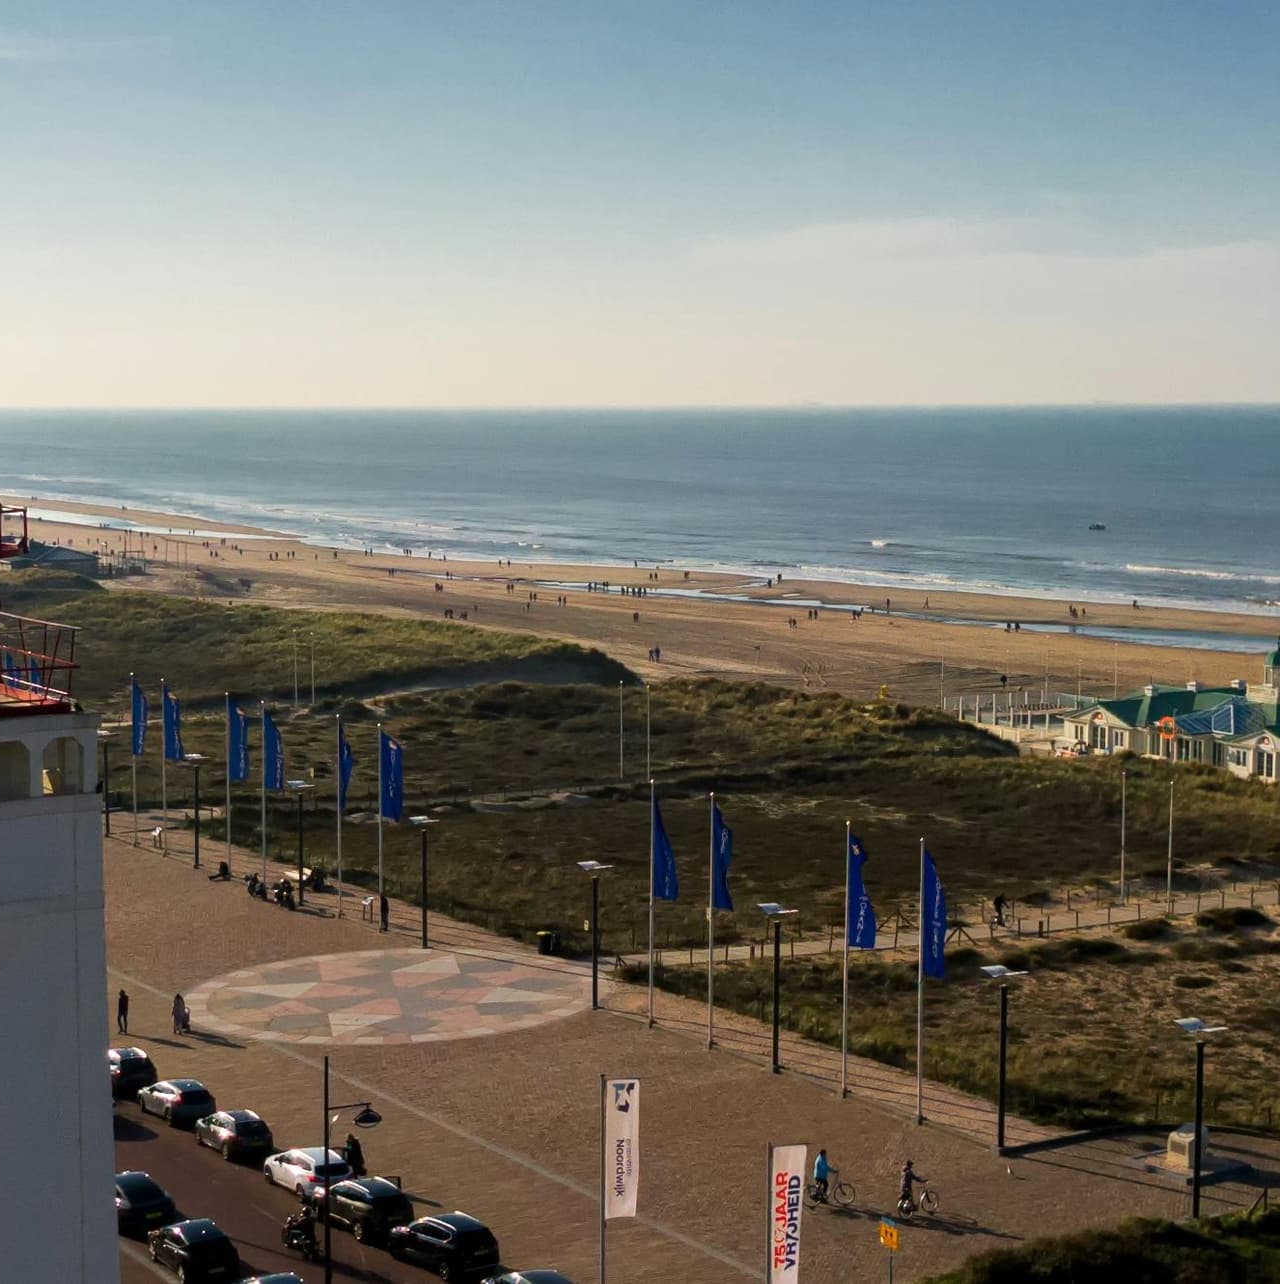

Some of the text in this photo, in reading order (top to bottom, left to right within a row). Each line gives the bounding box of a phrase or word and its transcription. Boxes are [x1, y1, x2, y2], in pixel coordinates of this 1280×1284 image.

[614, 1138, 626, 1197] Noordwijk
[774, 1172, 789, 1269] 75 JAAR
[783, 1175, 801, 1271] VRIJHEID
